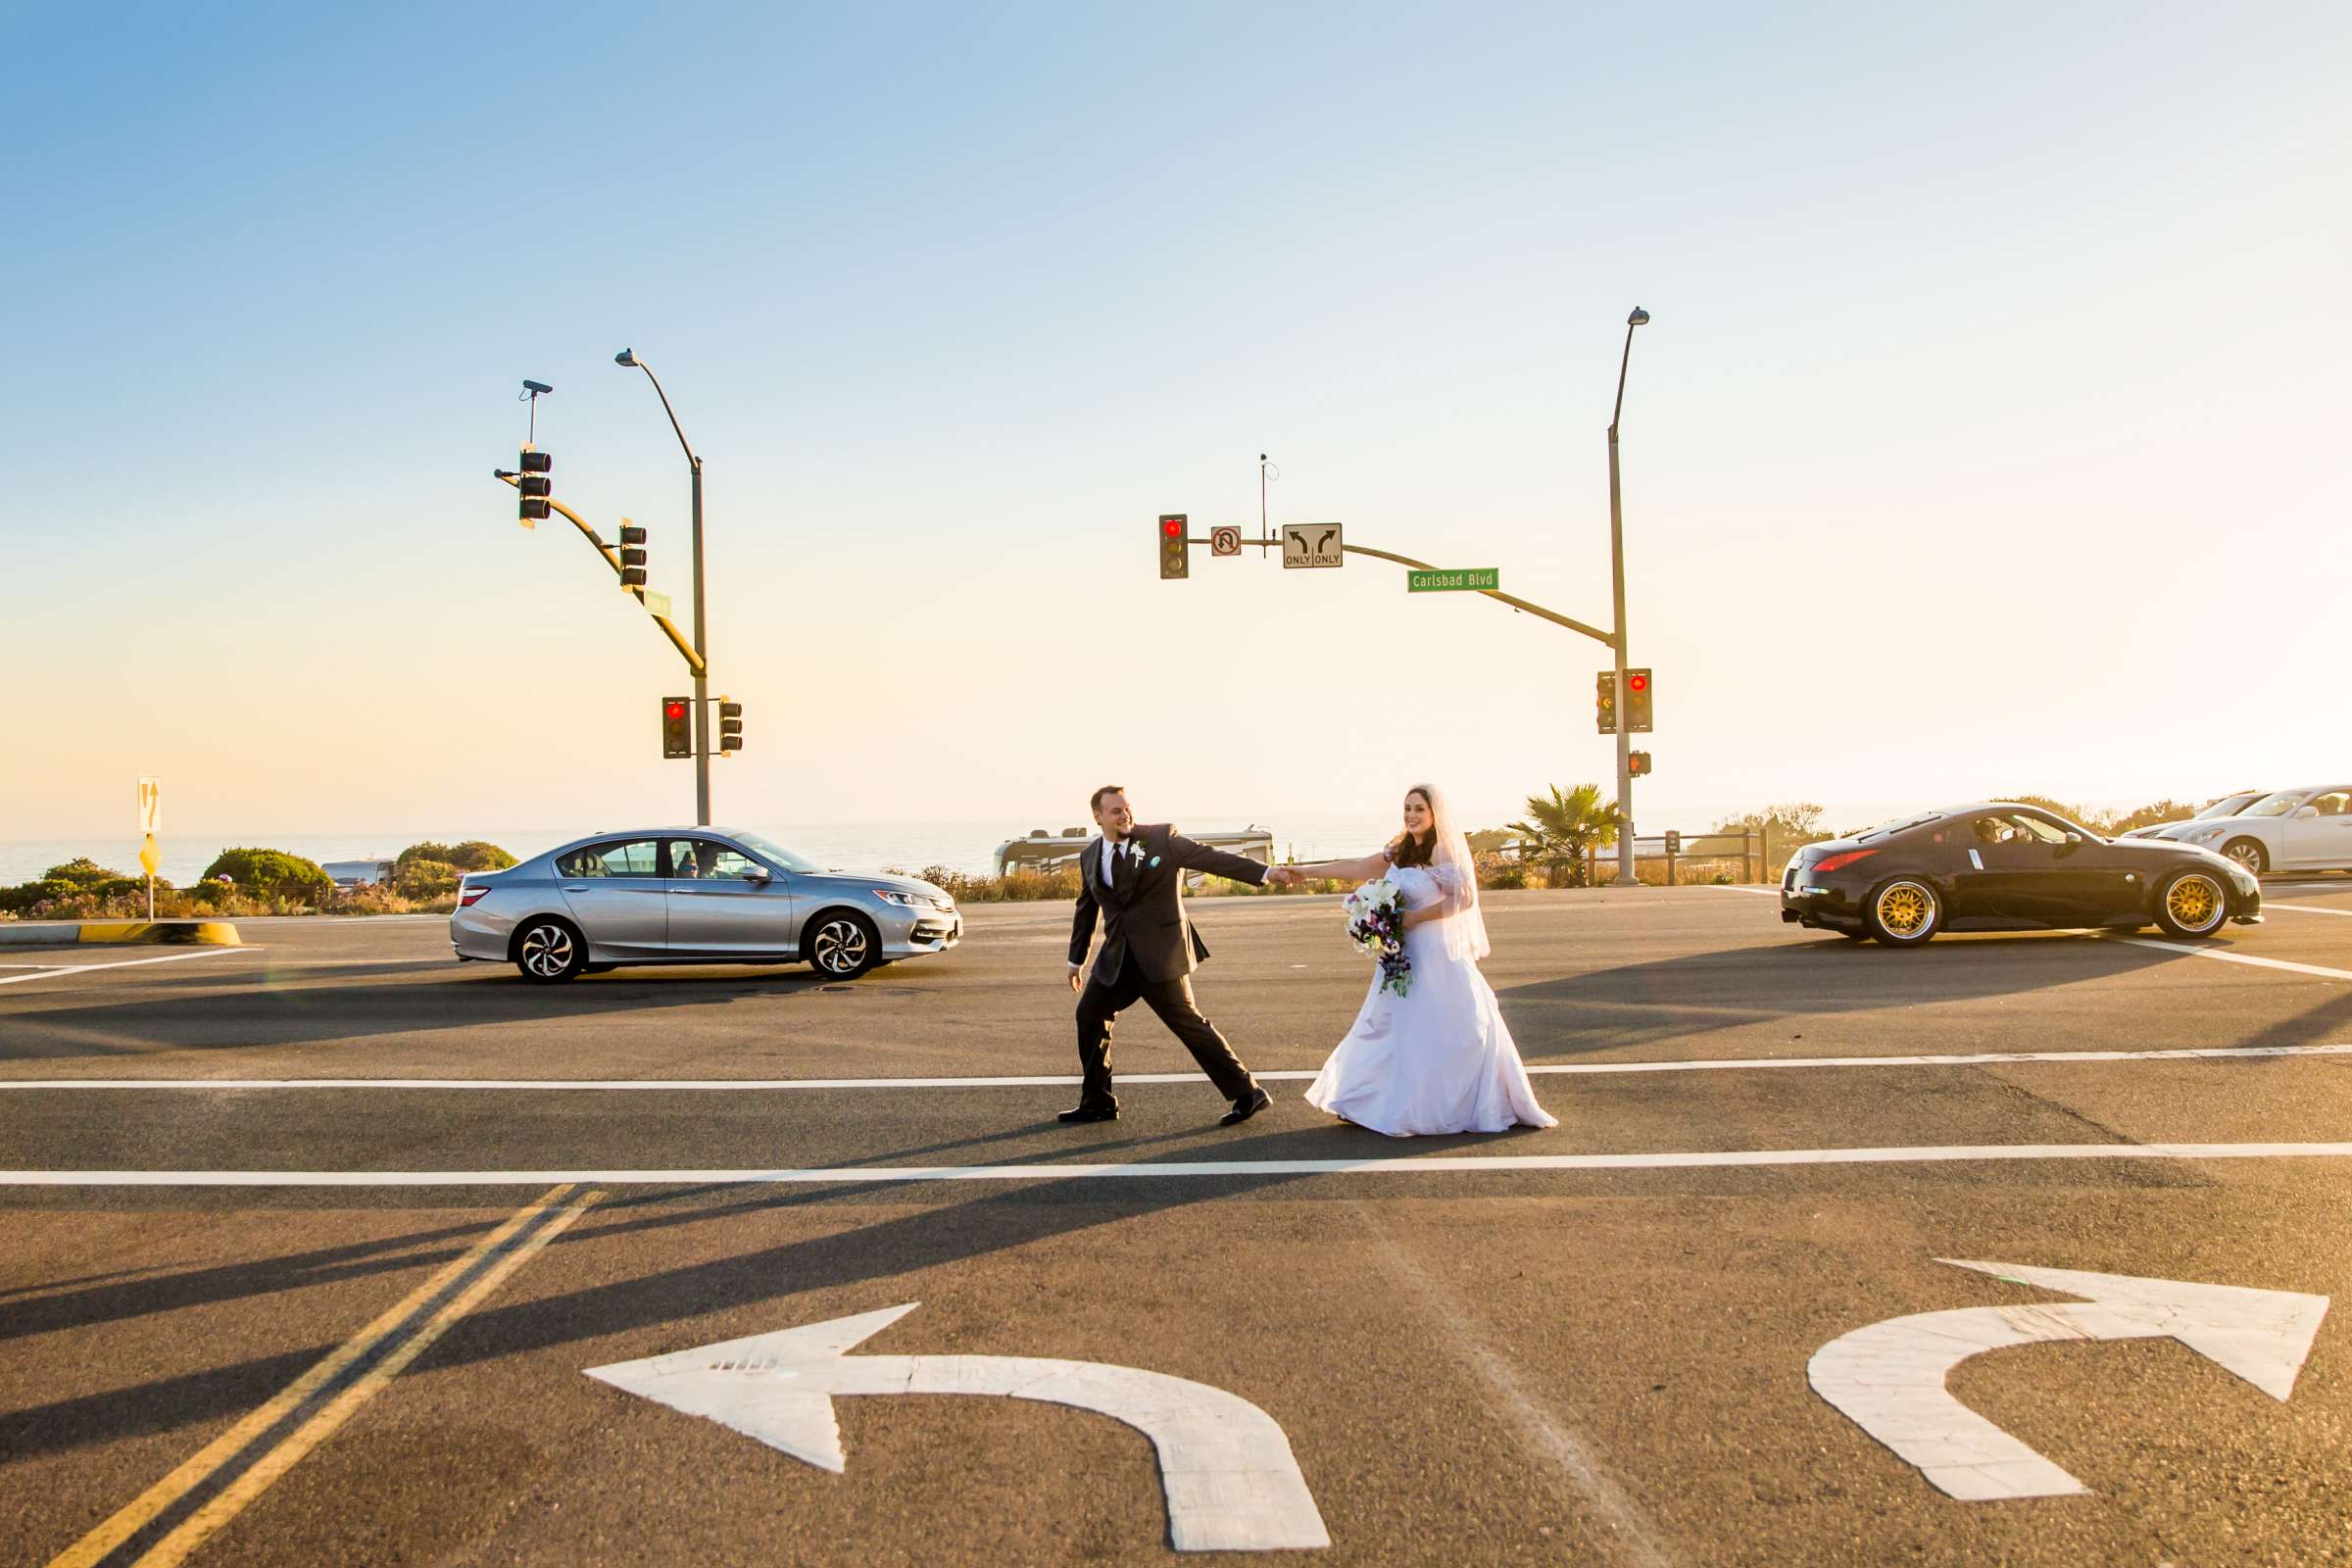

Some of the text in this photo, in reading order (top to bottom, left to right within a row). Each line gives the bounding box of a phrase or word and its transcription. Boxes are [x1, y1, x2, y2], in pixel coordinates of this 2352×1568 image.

[1286, 555, 1339, 564] ONLY ONLY
[1413, 572, 1493, 587] Carlsbad Blvd
